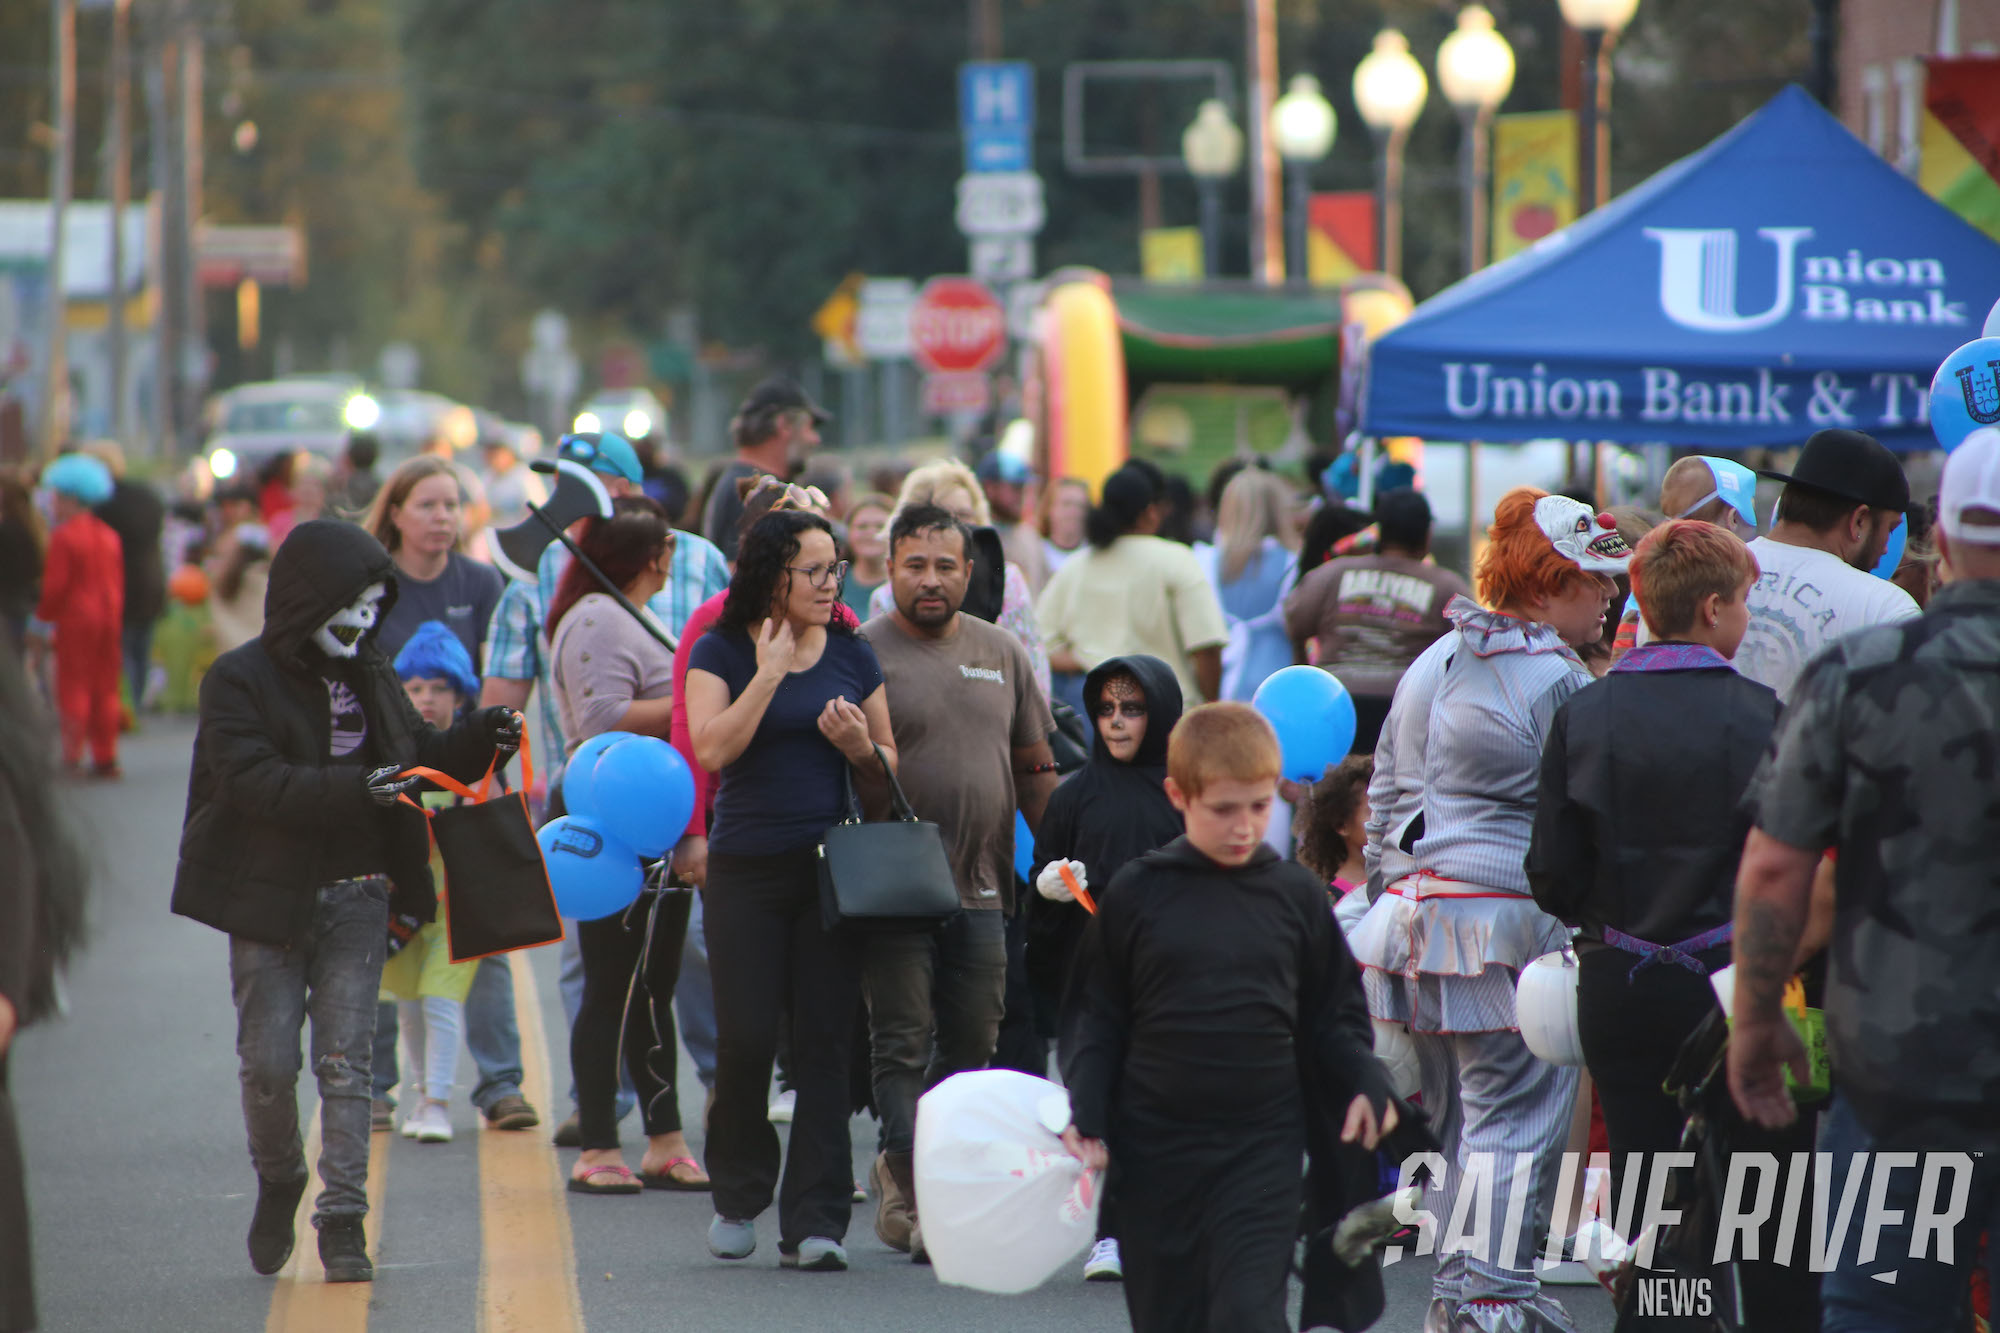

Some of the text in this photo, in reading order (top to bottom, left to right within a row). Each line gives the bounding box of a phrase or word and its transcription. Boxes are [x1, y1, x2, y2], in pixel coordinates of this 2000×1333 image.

[974, 73, 1018, 121] H
[1803, 285, 1969, 326] Bank
[1444, 363, 1622, 421] Union
[1642, 367, 1793, 425] Bank
[1806, 371, 1857, 426] &
[1753, 570, 1836, 633] RICA
